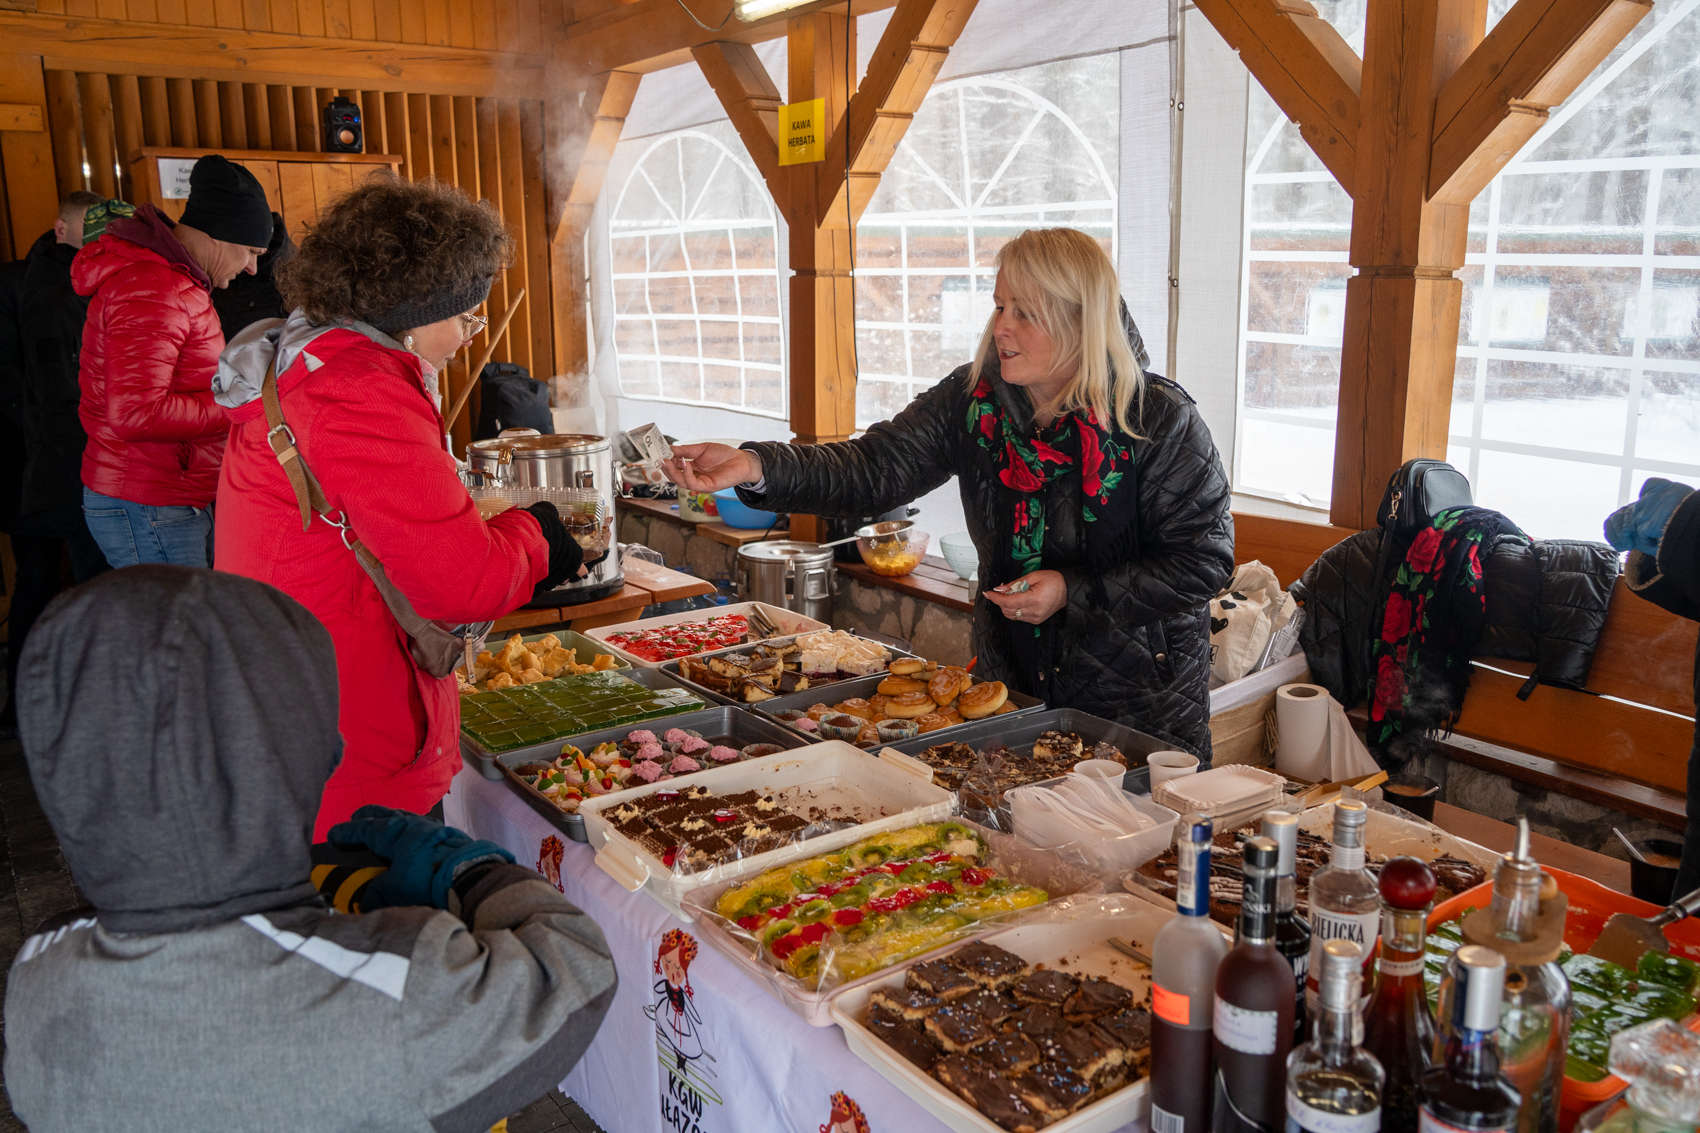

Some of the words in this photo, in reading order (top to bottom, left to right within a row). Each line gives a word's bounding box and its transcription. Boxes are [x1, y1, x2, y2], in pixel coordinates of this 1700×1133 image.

[792, 119, 811, 131] KAWA
[788, 134, 815, 147] HERBATA
[669, 1070, 702, 1118] KGW
